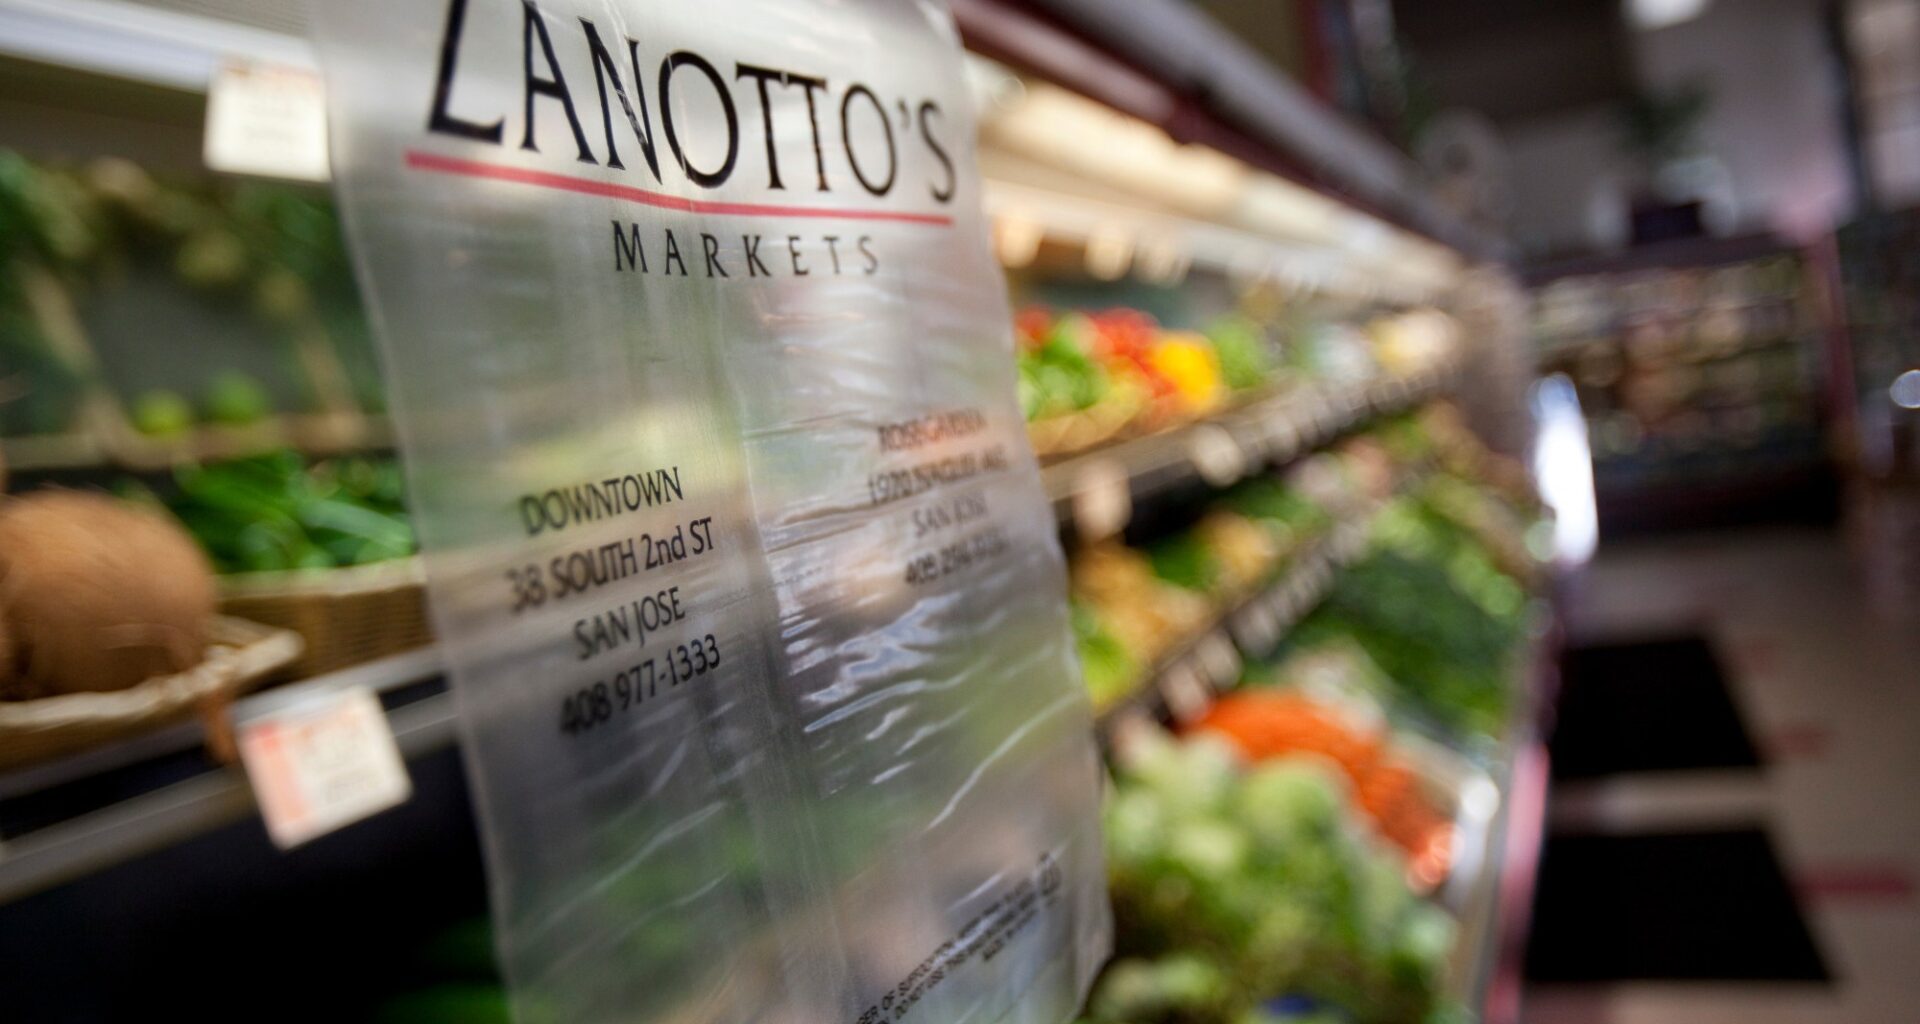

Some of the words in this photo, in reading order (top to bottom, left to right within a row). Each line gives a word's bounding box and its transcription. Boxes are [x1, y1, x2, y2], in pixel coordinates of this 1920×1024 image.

[428, 0, 957, 203] ZANOTTO'S
[611, 220, 880, 279] MARKETS
[519, 466, 684, 537] DOWNTOWN
[913, 501, 951, 538] SAN
[506, 561, 548, 614] 38
[550, 537, 639, 599] SOUTH
[641, 525, 688, 572] 2nd
[689, 516, 715, 556] ST
[573, 605, 631, 661] SAN
[632, 586, 686, 648] JOSE
[560, 681, 612, 736] 408
[615, 633, 721, 712] 977-1333
